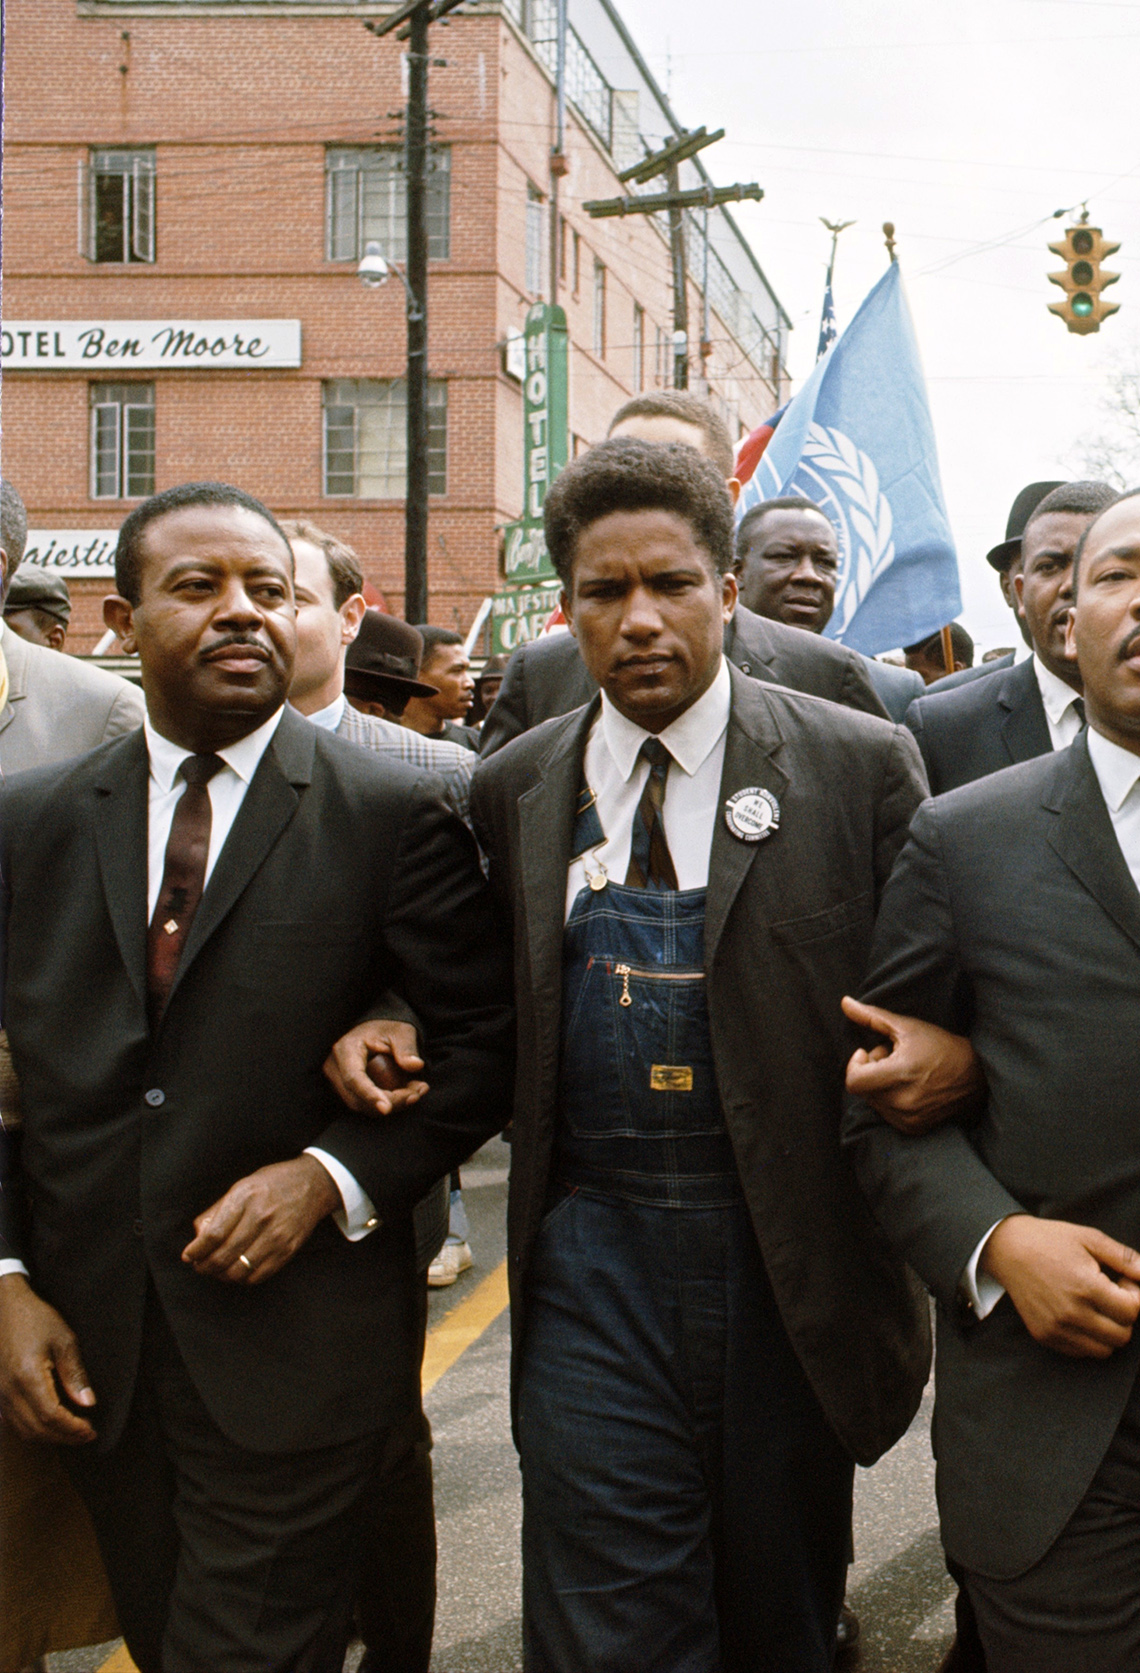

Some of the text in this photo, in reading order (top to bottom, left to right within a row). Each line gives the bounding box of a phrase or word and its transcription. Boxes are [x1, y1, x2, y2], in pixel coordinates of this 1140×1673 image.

[77, 328, 144, 358] Ben
[151, 328, 270, 357] Moore
[526, 333, 548, 518] HOTEL
[493, 588, 563, 617] MAJESTIC
[500, 613, 551, 650] CAF
[734, 811, 763, 830] OVERCOME
[743, 805, 764, 820] SHALL
